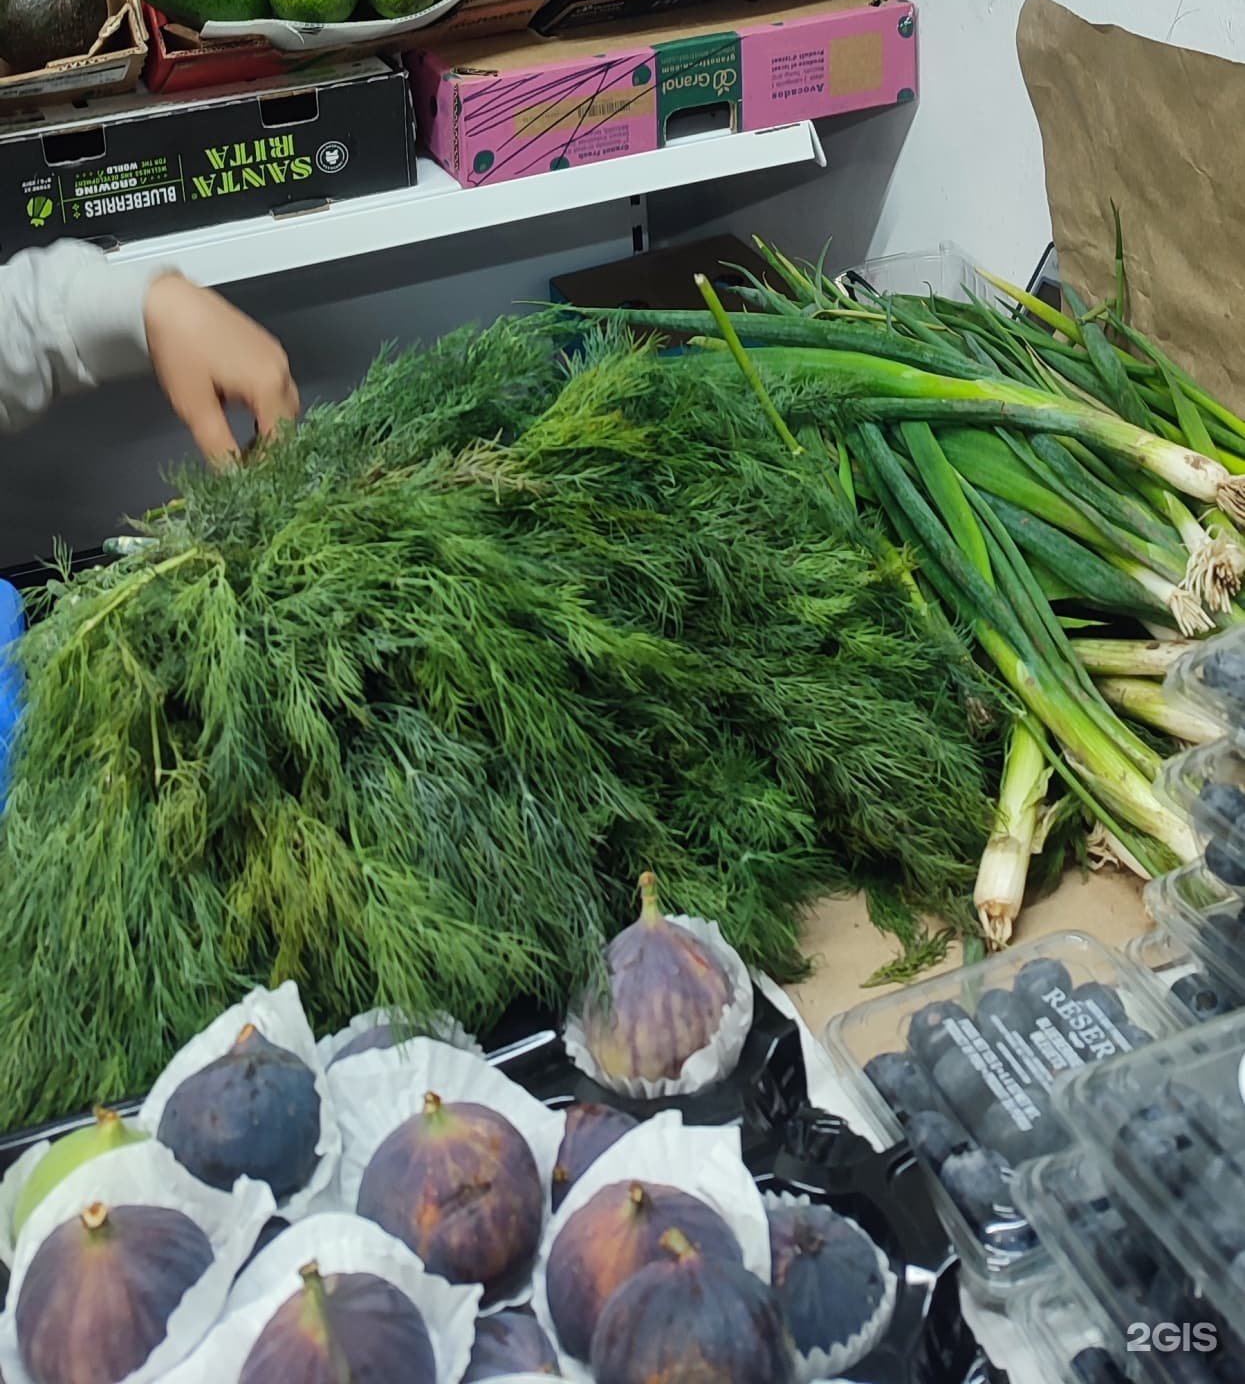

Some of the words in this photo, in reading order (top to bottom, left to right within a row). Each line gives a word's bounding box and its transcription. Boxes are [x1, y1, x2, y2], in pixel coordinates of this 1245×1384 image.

[772, 83, 824, 100] Avocados
[204, 134, 295, 170] RITA
[106, 163, 138, 175] WORLD
[192, 156, 313, 199] SANTA
[75, 179, 138, 197] GROWING
[84, 186, 177, 219] BLUEBERRIES
